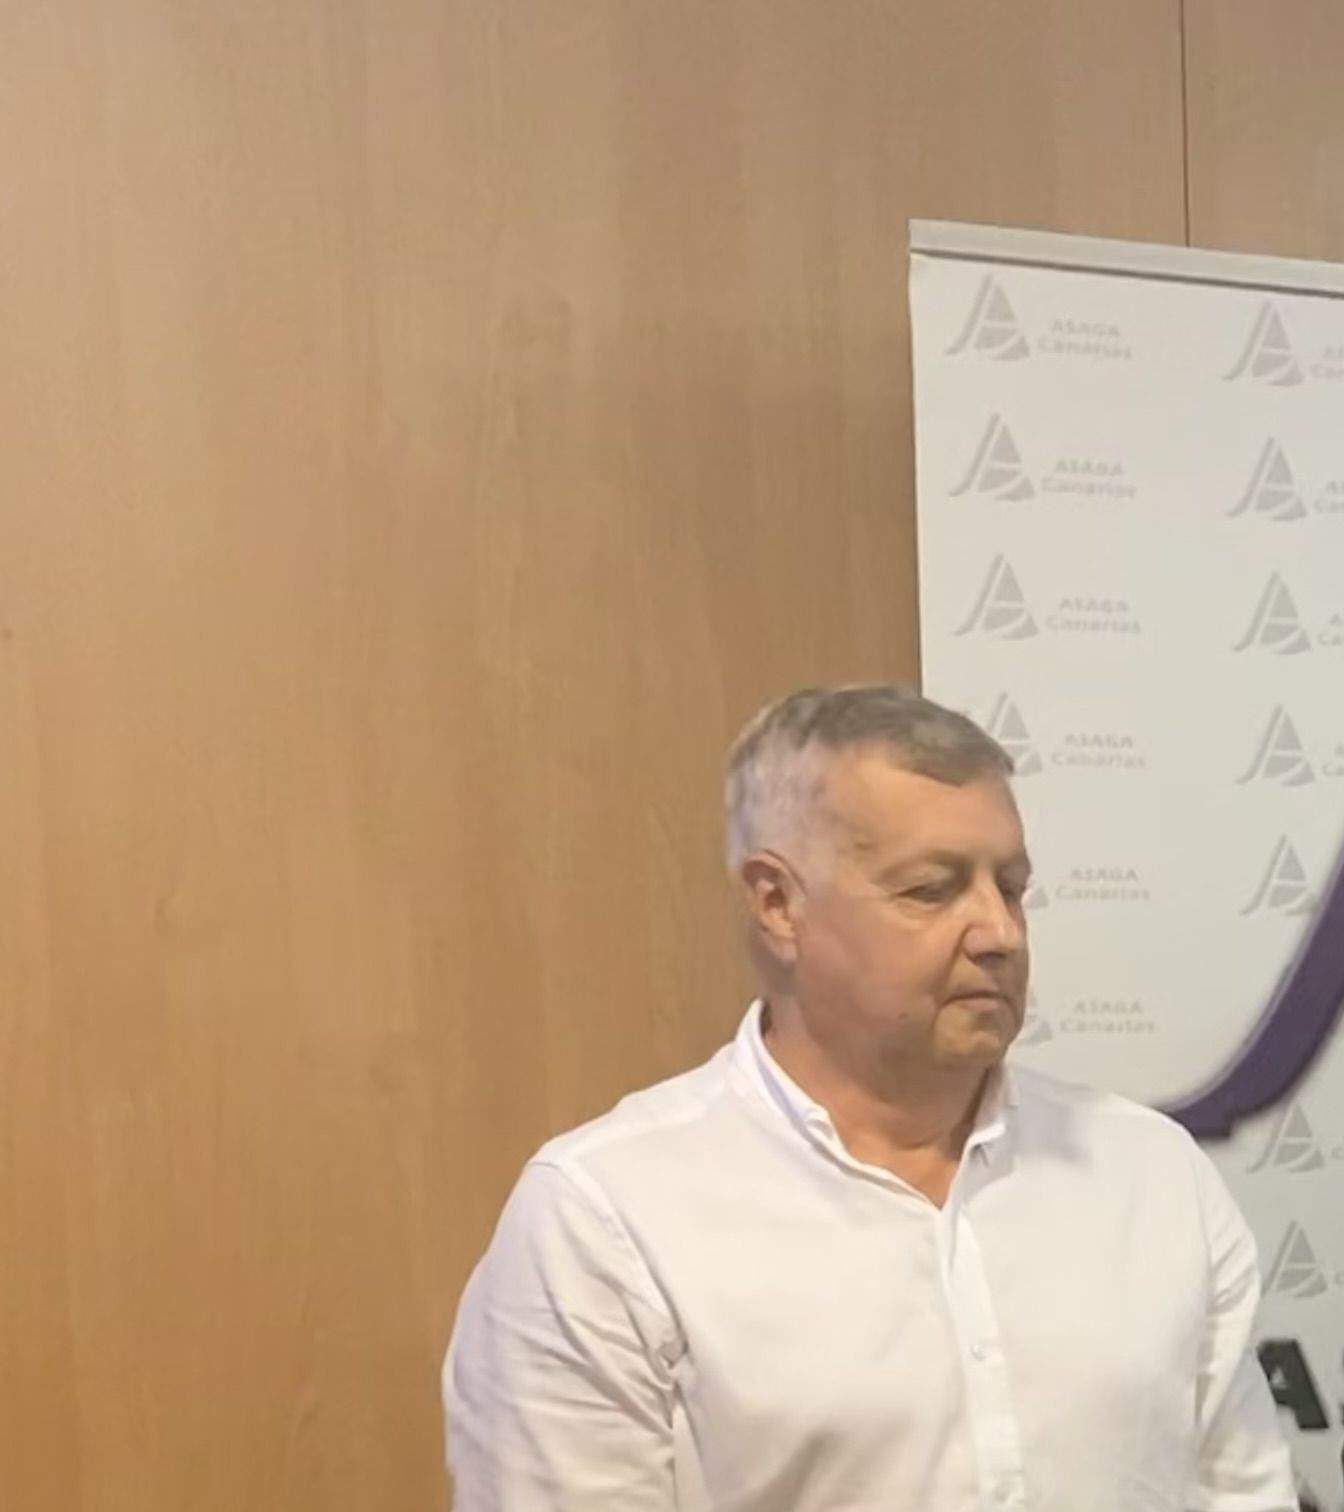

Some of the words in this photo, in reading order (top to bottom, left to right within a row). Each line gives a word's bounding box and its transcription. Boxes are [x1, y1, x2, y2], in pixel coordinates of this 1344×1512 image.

[1037, 337, 1133, 361] Canarias
[1041, 477, 1136, 500] Canarias
[1045, 614, 1142, 635] Canarias
[1051, 751, 1146, 771] Canarias
[1054, 884, 1151, 903] Canarias
[1059, 1017, 1155, 1036] Canarias
